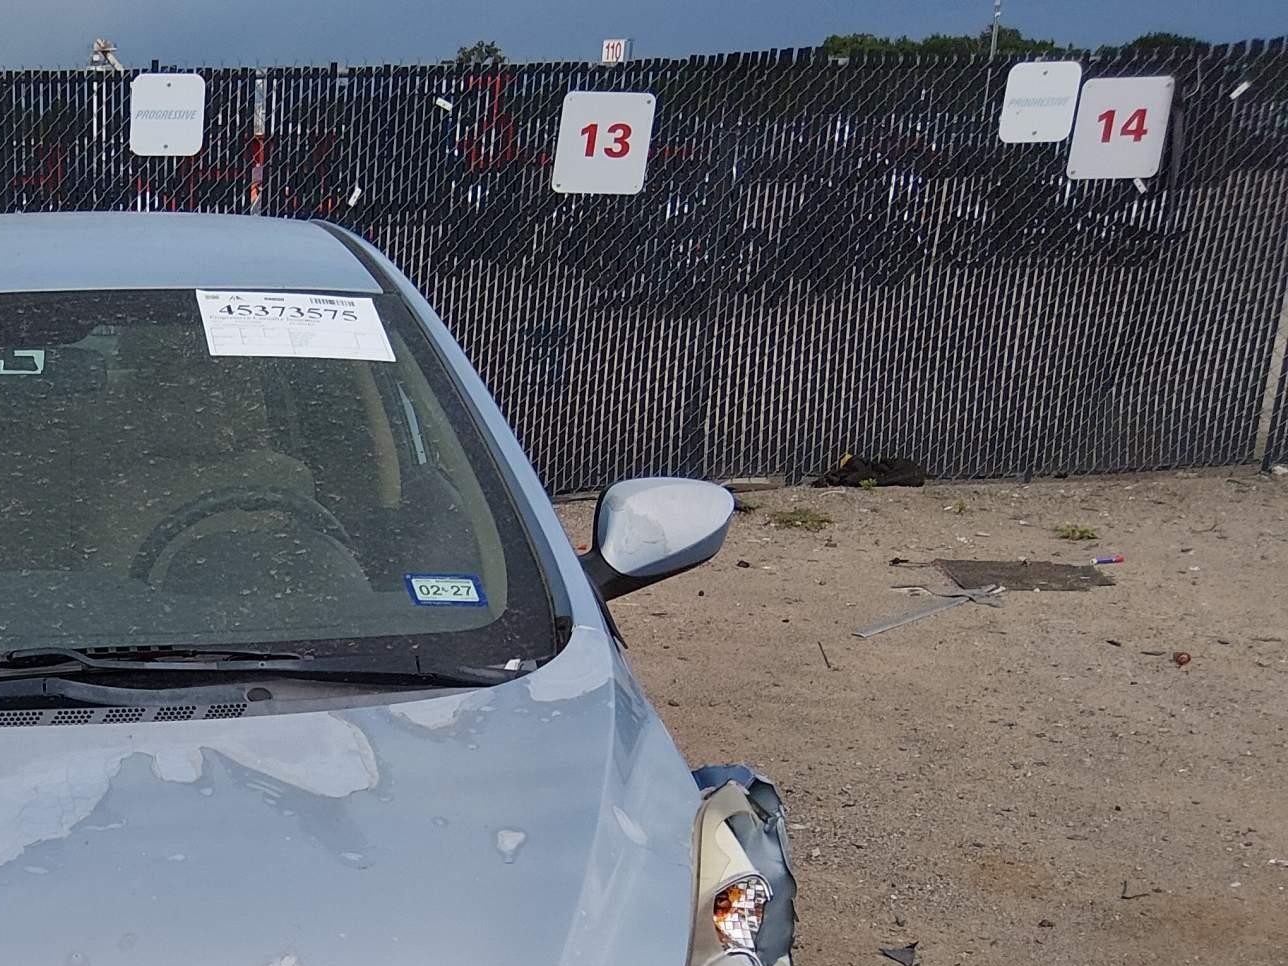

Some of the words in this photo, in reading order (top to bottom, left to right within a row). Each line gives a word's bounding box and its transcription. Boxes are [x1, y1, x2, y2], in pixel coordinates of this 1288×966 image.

[605, 42, 622, 60] 110
[135, 109, 198, 121] PROGRESSIVE
[1096, 108, 1148, 143] 14
[580, 123, 632, 158] 13
[219, 304, 358, 322] 45373575
